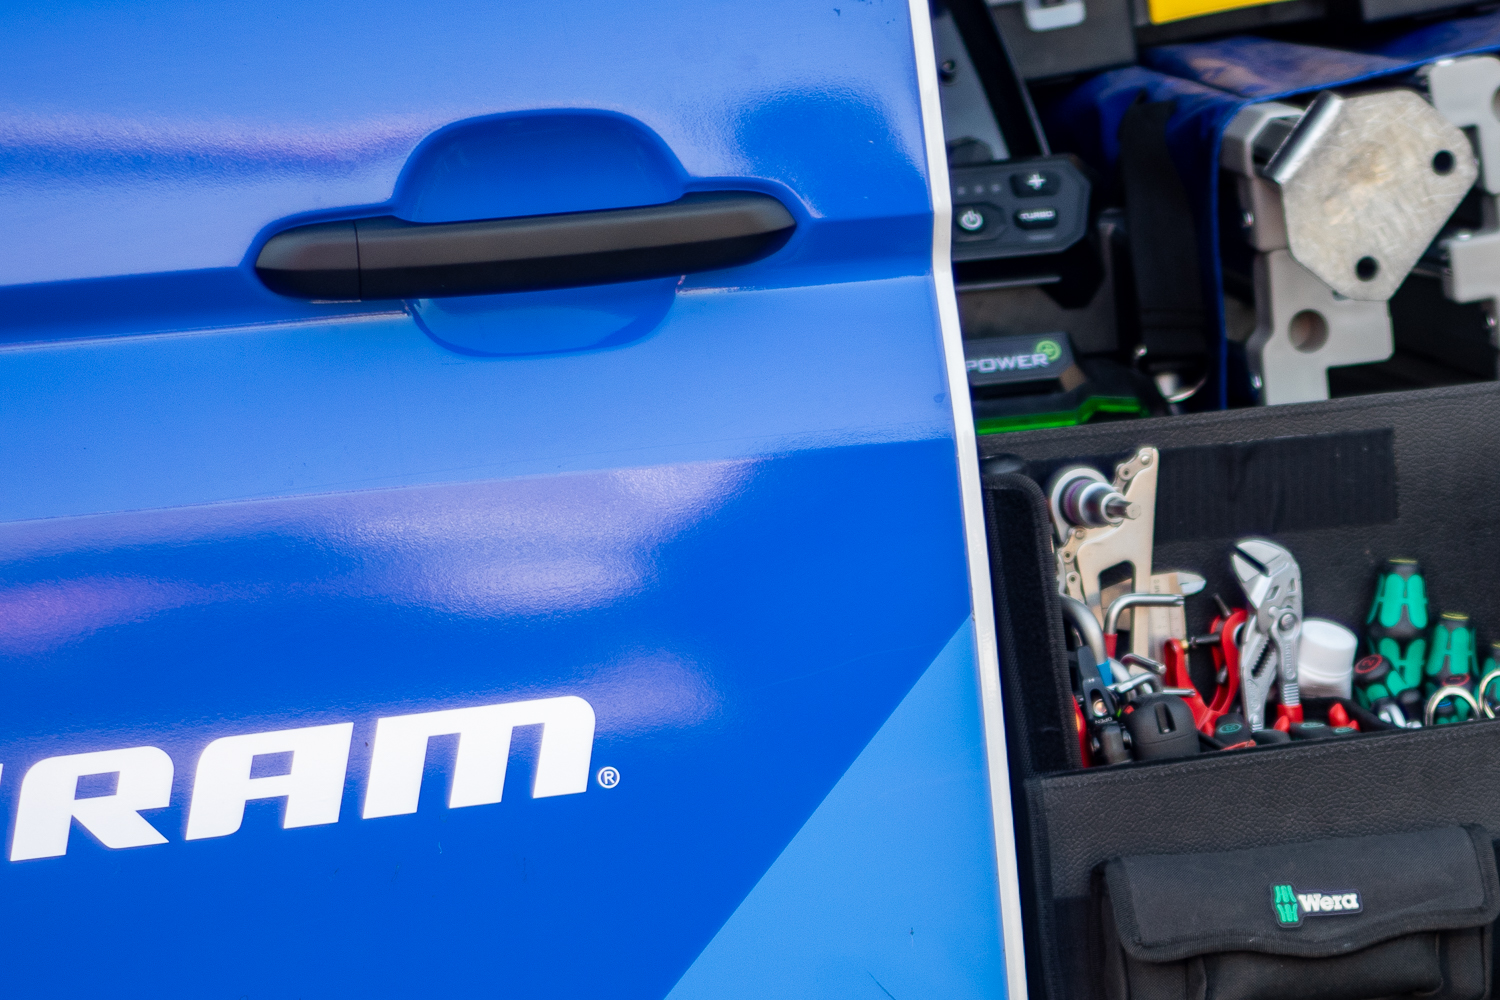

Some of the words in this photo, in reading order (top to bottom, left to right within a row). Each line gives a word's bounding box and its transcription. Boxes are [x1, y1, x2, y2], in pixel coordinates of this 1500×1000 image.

[1018, 209, 1055, 220] TURBO
[965, 352, 1049, 372] POWER
[0, 695, 596, 862] RAM
[1298, 892, 1360, 912] Wera
